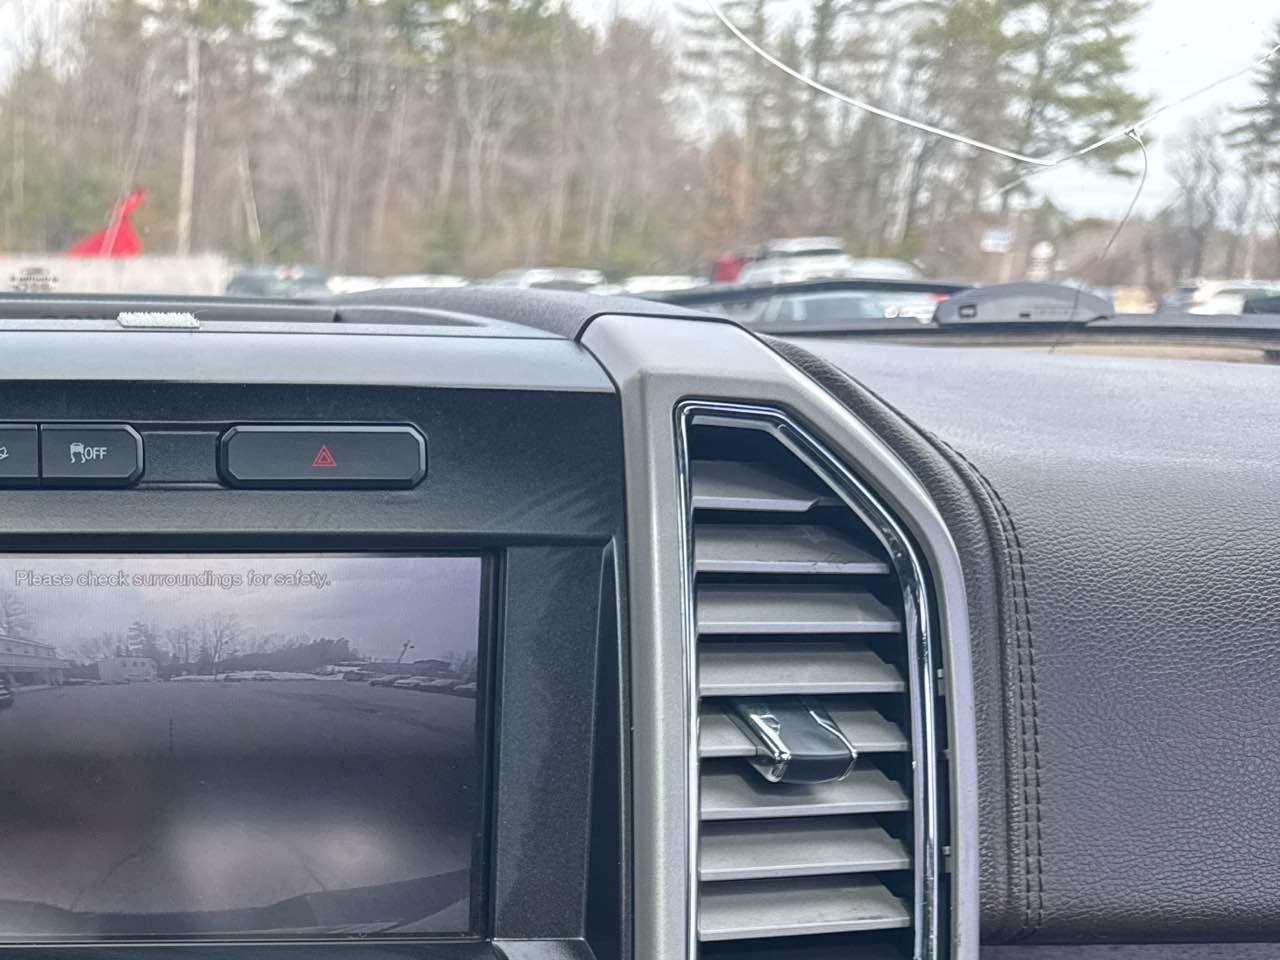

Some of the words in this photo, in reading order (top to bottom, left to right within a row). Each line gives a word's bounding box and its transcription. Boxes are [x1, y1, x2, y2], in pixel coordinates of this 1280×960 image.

[85, 446, 107, 460] OFF
[15, 569, 73, 586] Please
[76, 569, 129, 586] check
[132, 569, 243, 589] surroundings
[247, 569, 272, 586] for
[274, 569, 331, 589] safety.
